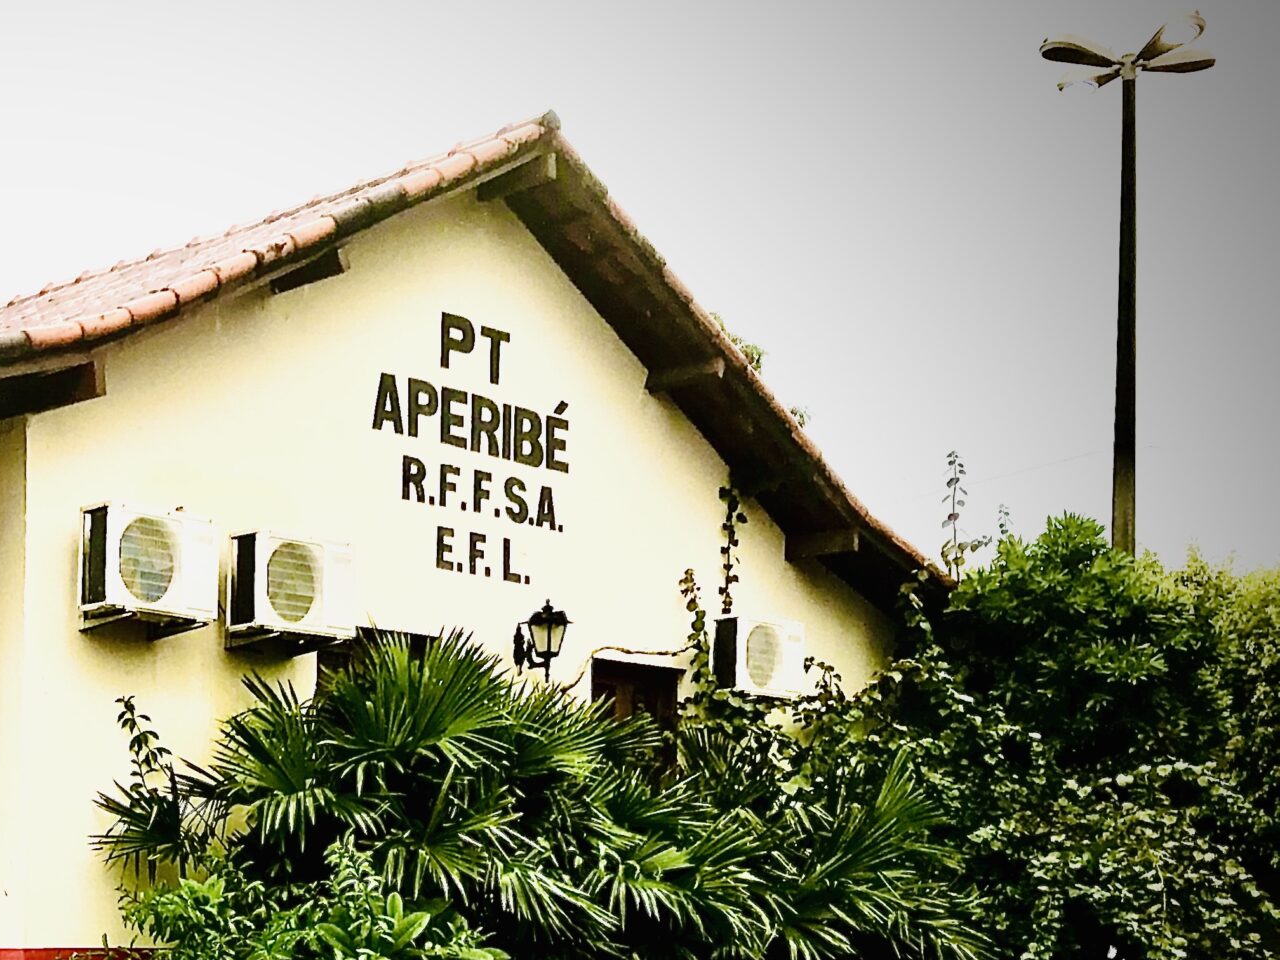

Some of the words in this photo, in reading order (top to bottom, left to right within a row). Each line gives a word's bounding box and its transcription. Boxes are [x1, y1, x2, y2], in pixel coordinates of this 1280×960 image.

[440, 312, 510, 385] PT
[372, 372, 569, 474] APERIBÉ
[401, 455, 564, 533] R.F.F.S.A.
[436, 526, 531, 585] E.F.L.
